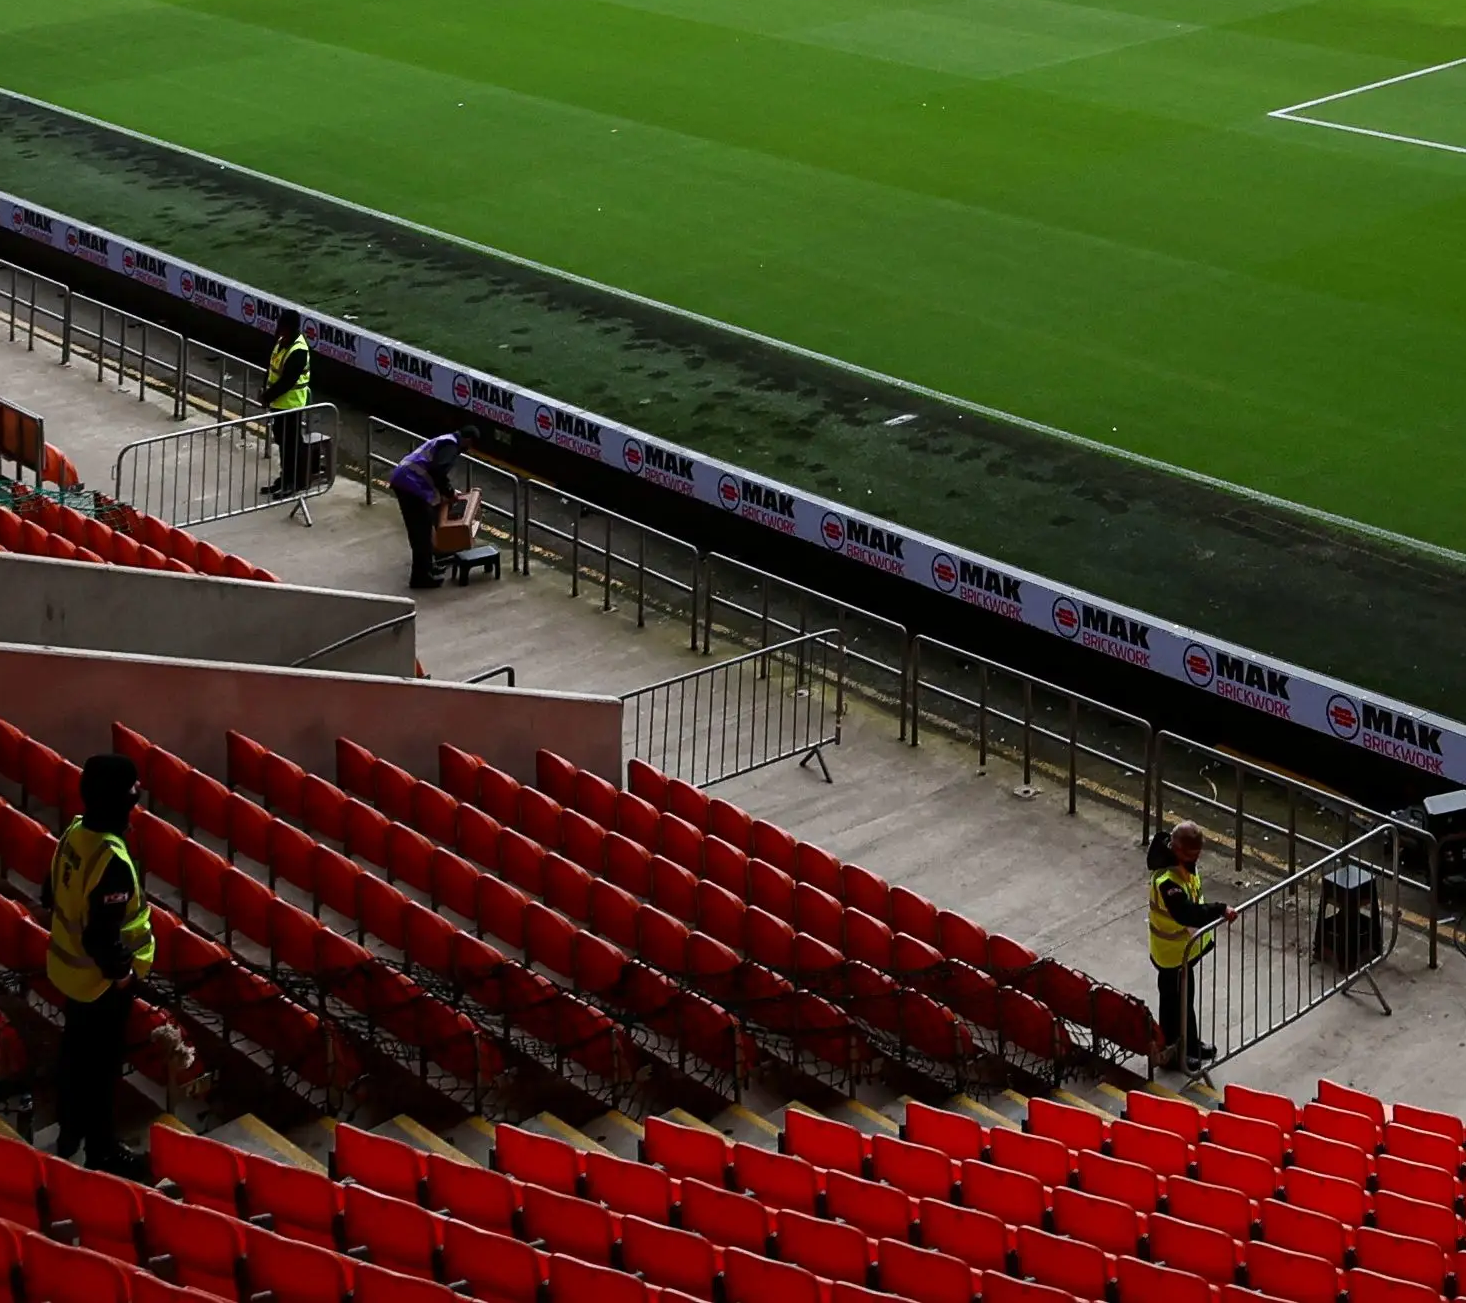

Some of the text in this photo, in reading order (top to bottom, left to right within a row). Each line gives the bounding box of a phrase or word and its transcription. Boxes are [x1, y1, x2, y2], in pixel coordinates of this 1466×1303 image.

[24, 208, 52, 234] MAK
[79, 229, 109, 255] MAK
[135, 252, 166, 279] MAK
[195, 273, 228, 302] MAK
[319, 321, 356, 348] MAK
[394, 349, 433, 382] MAK
[474, 380, 515, 412] MAK
[555, 408, 601, 446] MAK
[555, 433, 602, 460] BRICKWORK
[645, 443, 694, 481] MAK
[645, 467, 695, 494] BRICKWORK
[742, 481, 795, 519] MAK
[742, 505, 796, 535] BRICKWORK
[847, 519, 904, 559] MAK
[847, 544, 905, 575] BRICKWORK
[960, 561, 1022, 603] MAK
[960, 585, 1023, 622] BRICKWORK
[1082, 605, 1150, 649] MAK
[1082, 631, 1151, 668] BRICKWORK
[1217, 653, 1290, 700] MAK
[1217, 681, 1291, 719] BRICKWORK
[1363, 703, 1443, 755] MAK
[1363, 732, 1444, 774] BRICKWORK
